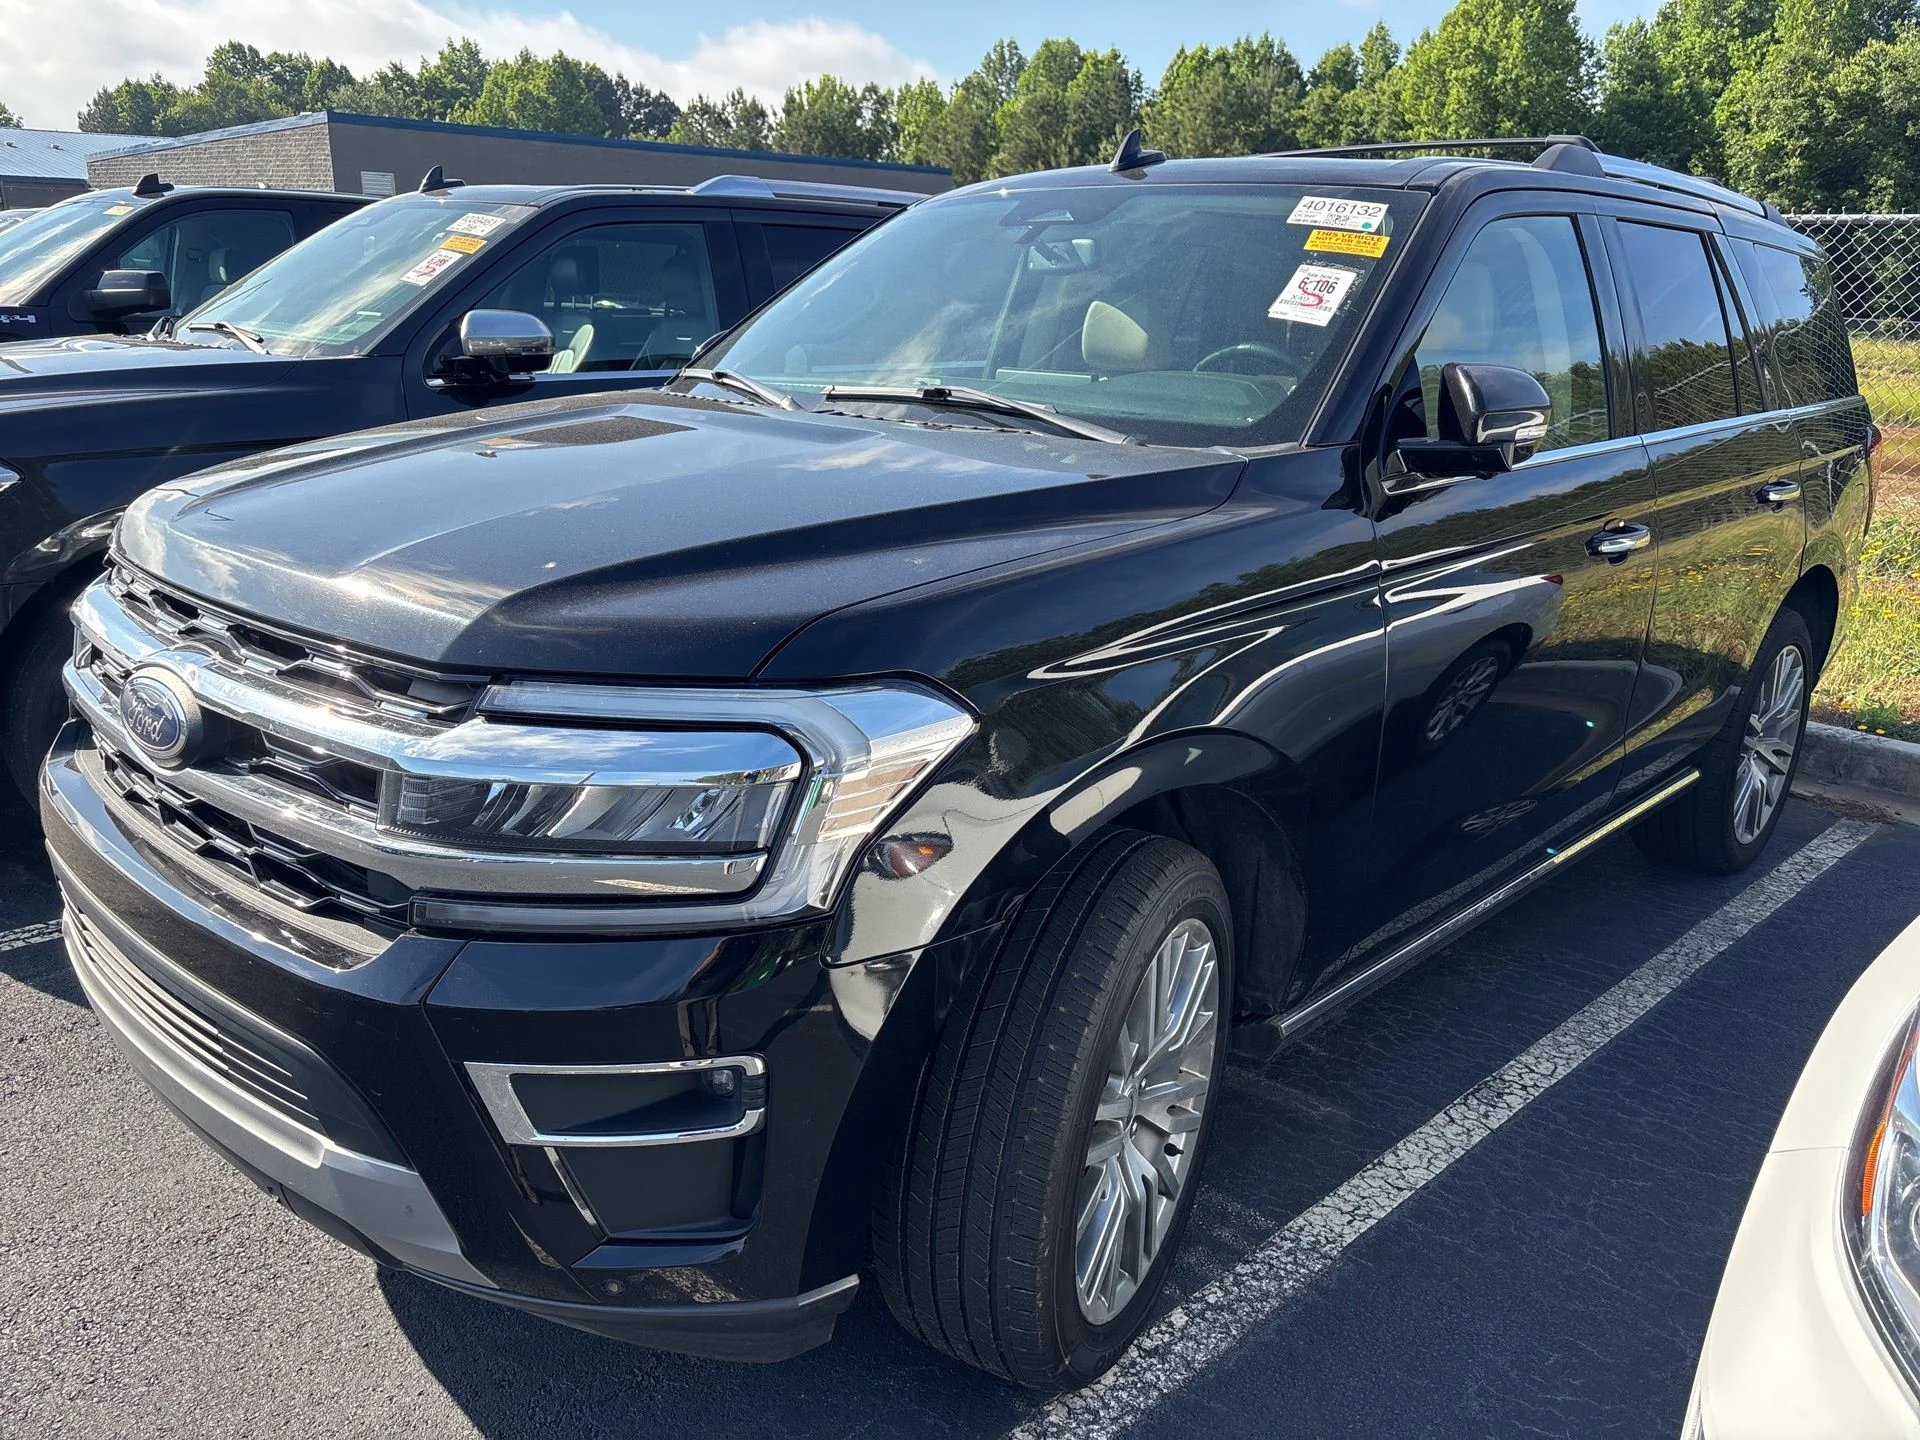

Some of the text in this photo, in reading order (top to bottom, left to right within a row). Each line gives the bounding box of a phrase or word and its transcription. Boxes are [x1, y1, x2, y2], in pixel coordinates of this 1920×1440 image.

[1303, 200, 1382, 217] 4016132
[1341, 233, 1384, 242] VEHICLE
[127, 692, 166, 742] Ford
